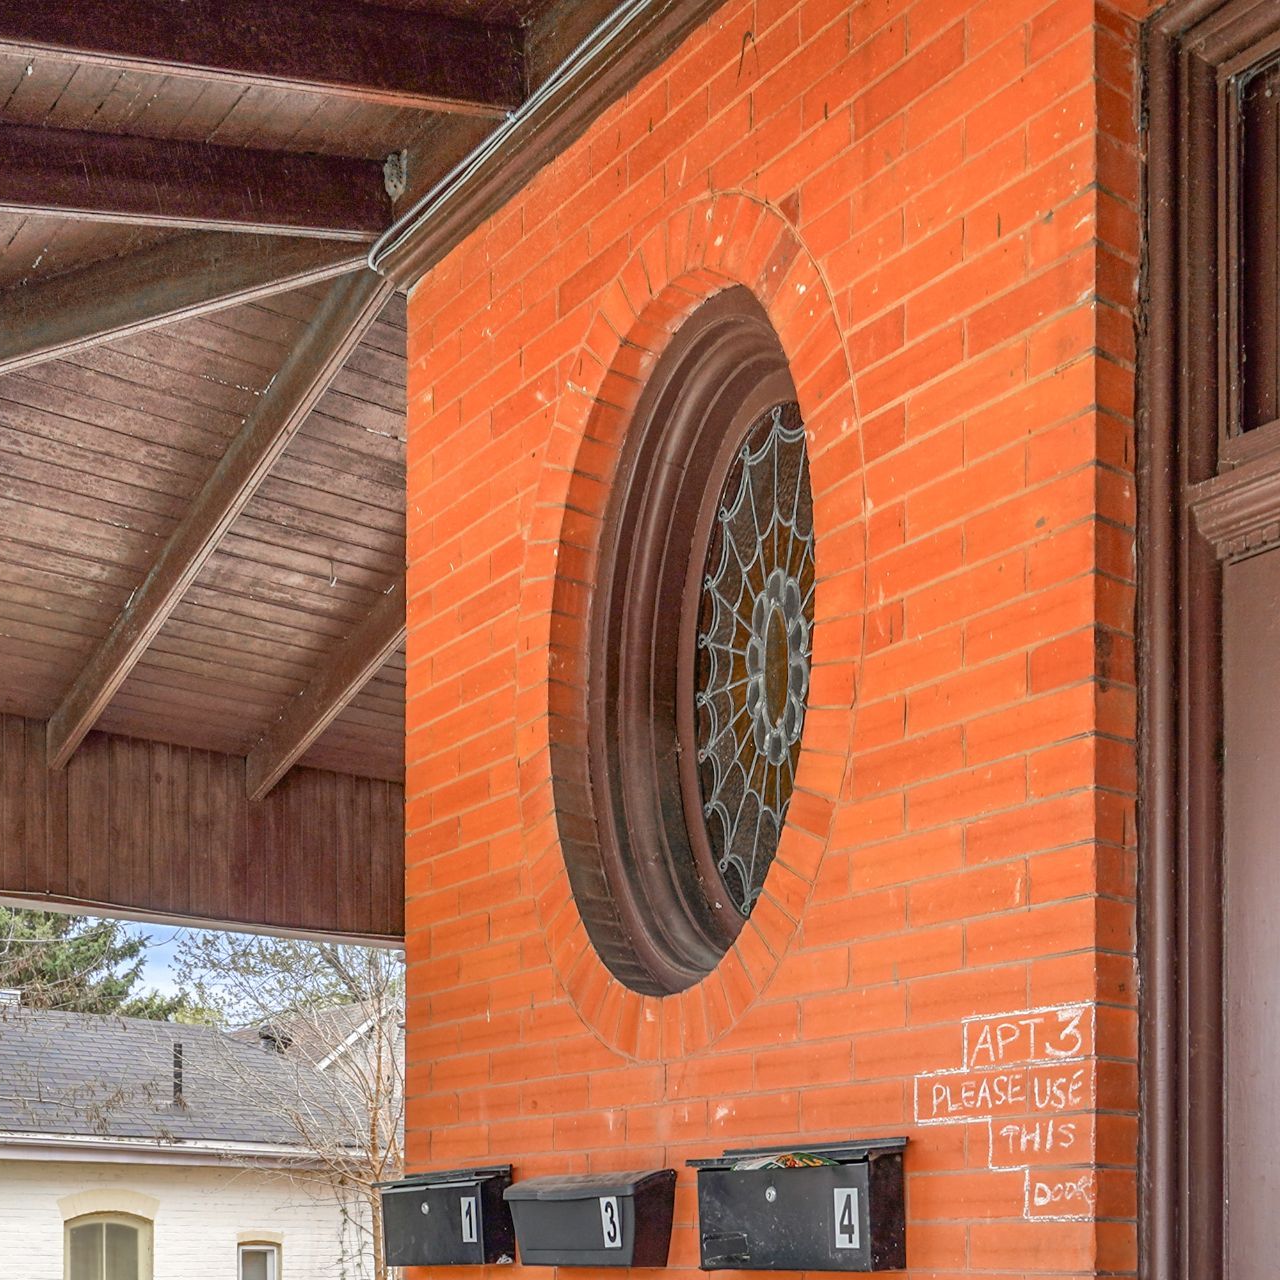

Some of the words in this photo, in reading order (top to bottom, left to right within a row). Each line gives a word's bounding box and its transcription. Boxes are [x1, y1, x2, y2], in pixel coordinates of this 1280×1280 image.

[971, 1018, 1044, 1066] APT
[1045, 1009, 1084, 1057] 3
[931, 1075, 1025, 1115] PLEASE
[1034, 1070, 1084, 1111] USE
[1000, 1120, 1076, 1153] THIS
[604, 1200, 617, 1243] 3
[839, 1193, 855, 1245] 4
